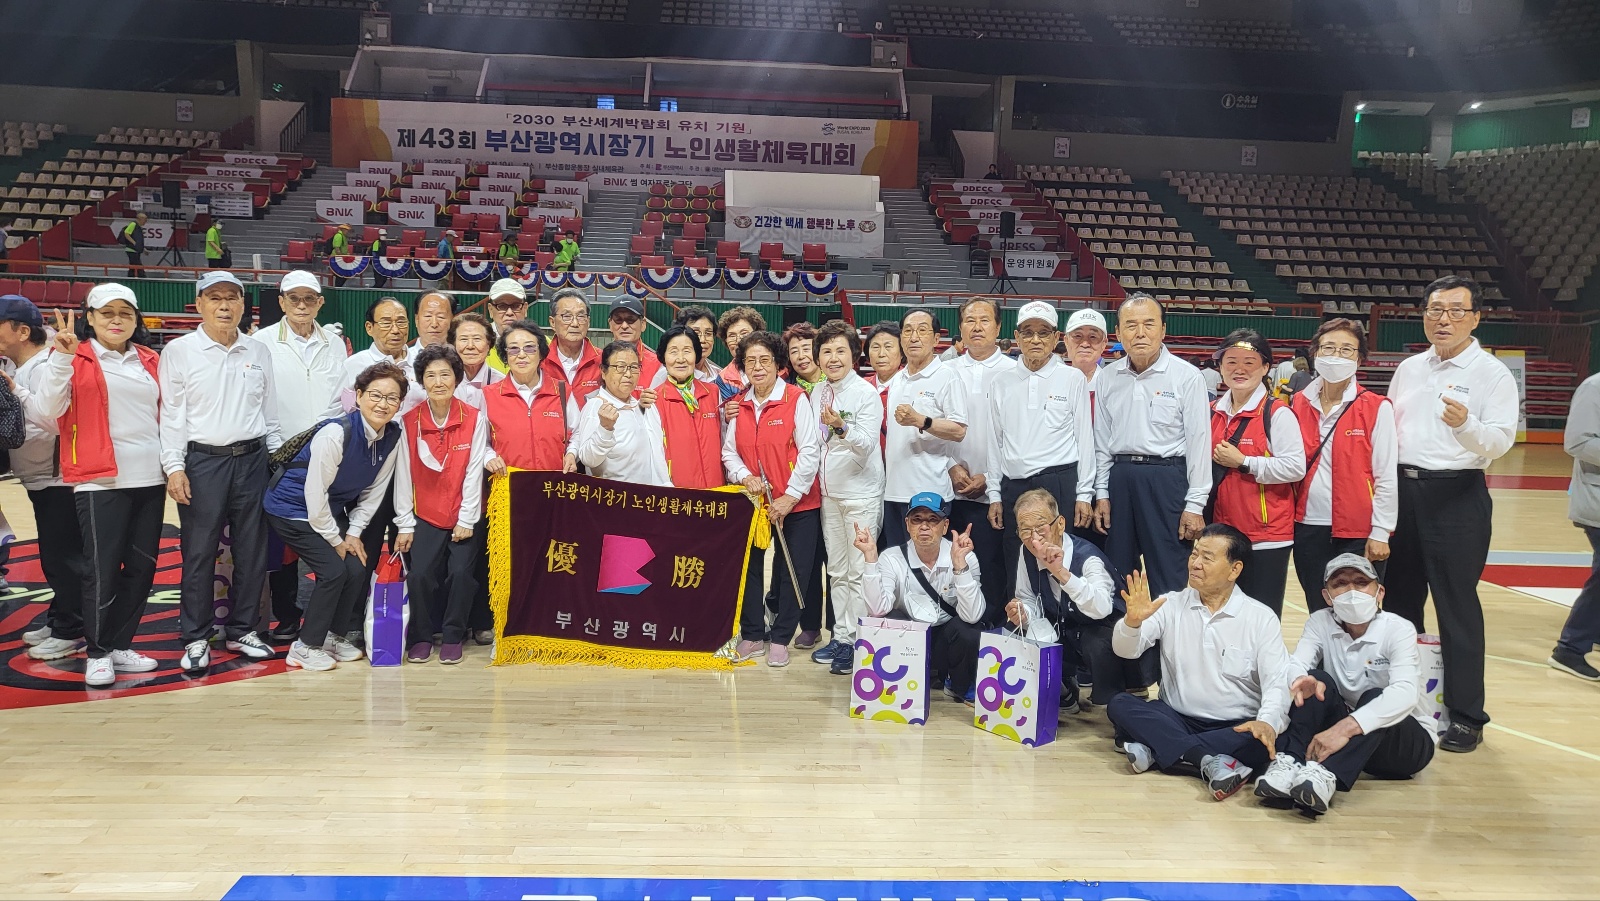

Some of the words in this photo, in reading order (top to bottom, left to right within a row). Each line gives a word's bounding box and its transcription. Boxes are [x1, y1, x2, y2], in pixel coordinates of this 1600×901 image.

[562, 115, 670, 130] 부산세계박람회
[677, 120, 708, 132] 유치
[397, 127, 477, 150] 제43회
[484, 129, 655, 159] 부산광역시장기
[664, 136, 856, 167] 노인생활체육대회
[234, 157, 267, 165] PRESS
[197, 182, 234, 192] PRESS
[355, 179, 380, 188] BNK
[421, 181, 446, 190] BNK
[603, 178, 628, 187] BNK
[488, 184, 514, 193] BNK
[554, 186, 579, 195] BNK
[341, 193, 367, 201] BNK
[410, 195, 436, 204] BNK
[479, 197, 505, 206] BNK
[326, 207, 354, 217] BNK
[398, 210, 425, 220] BNK
[754, 215, 782, 228] 건강한
[785, 217, 804, 229] 백세
[806, 217, 835, 230] 행복한
[837, 219, 856, 231] 노후
[1000, 242, 1035, 251] PRESS
[1006, 257, 1055, 270] 운영위원회
[542, 480, 627, 509] 부산광역시장기
[631, 493, 728, 519] 노인생활체육대회
[545, 538, 579, 575] 優
[671, 555, 705, 589] 勝
